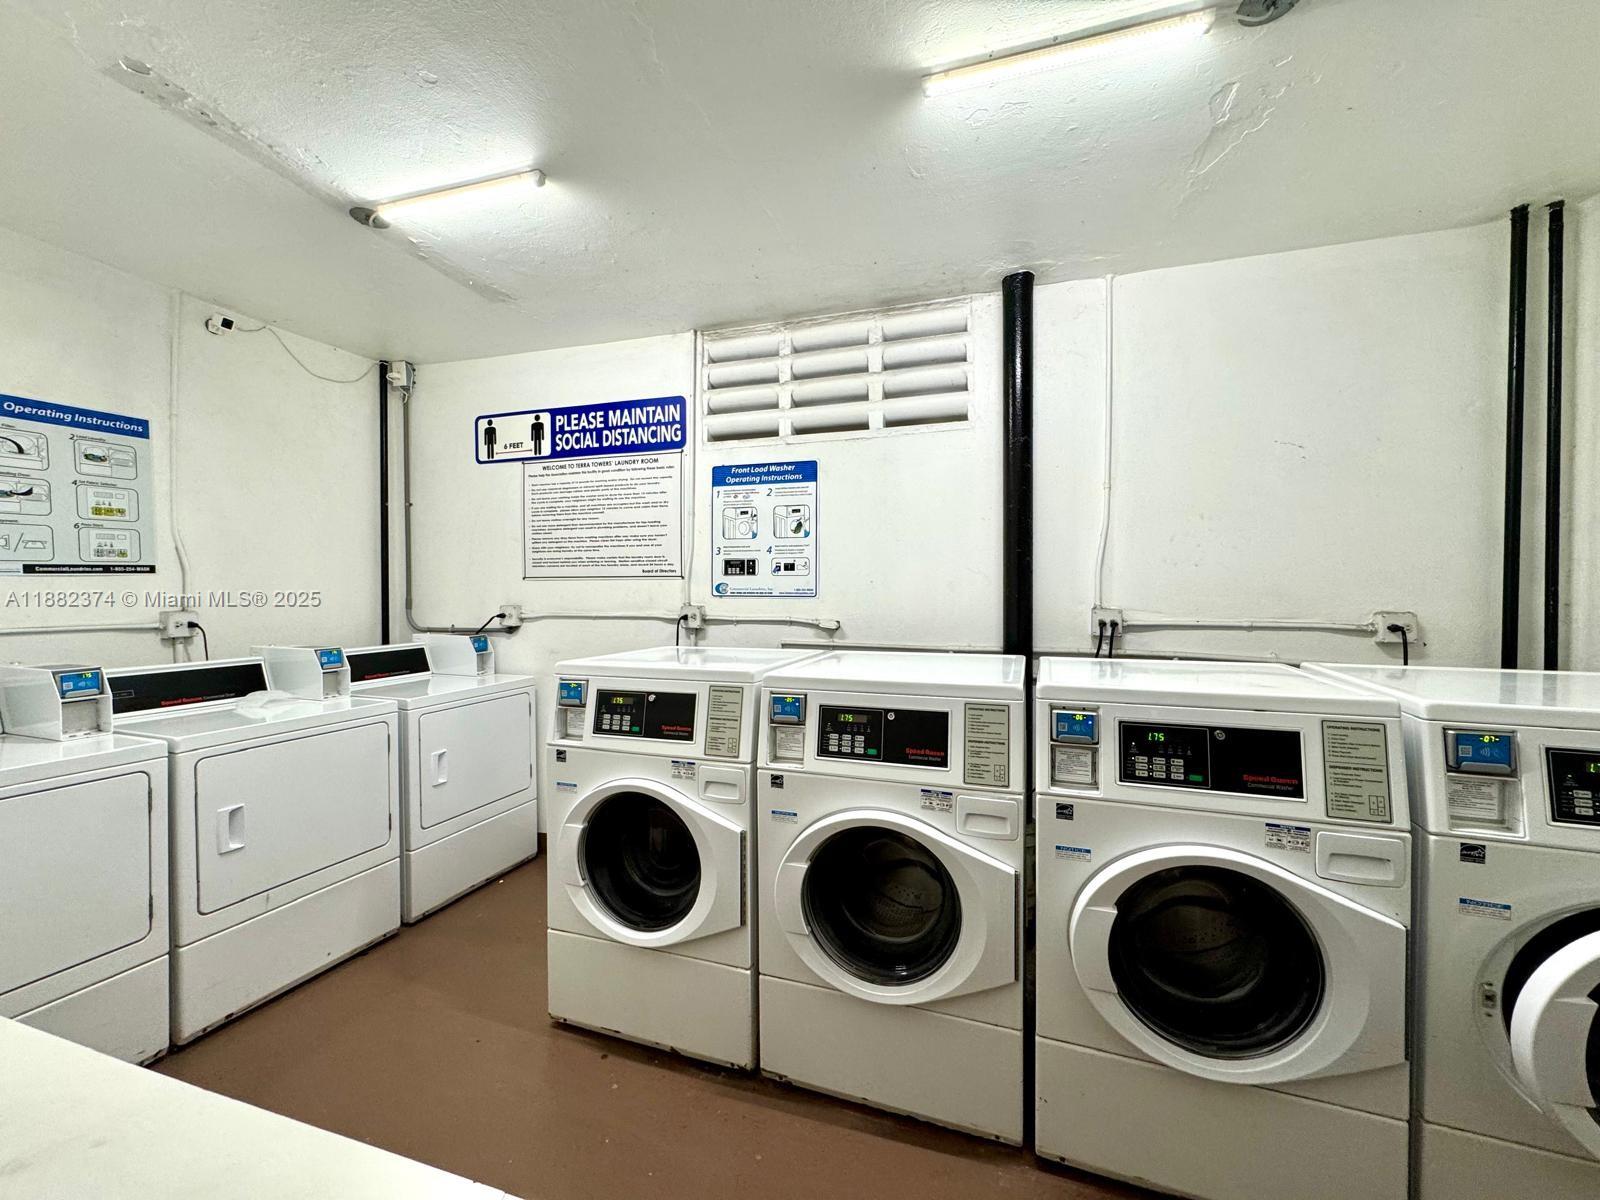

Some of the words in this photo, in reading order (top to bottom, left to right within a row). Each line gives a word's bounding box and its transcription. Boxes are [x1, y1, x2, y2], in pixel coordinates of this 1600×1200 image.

[3, 402, 72, 422] Operating
[74, 414, 143, 432] Instructions
[556, 412, 604, 431] PLEASE
[608, 404, 680, 427] MAINTAIN
[556, 432, 599, 451] SOCIAL
[602, 424, 682, 446] DISTANCING
[726, 475, 760, 484] Operating
[761, 474, 802, 482] Instructions
[767, 488, 773, 496] 2
[716, 547, 721, 555] 3
[767, 546, 772, 554] 4
